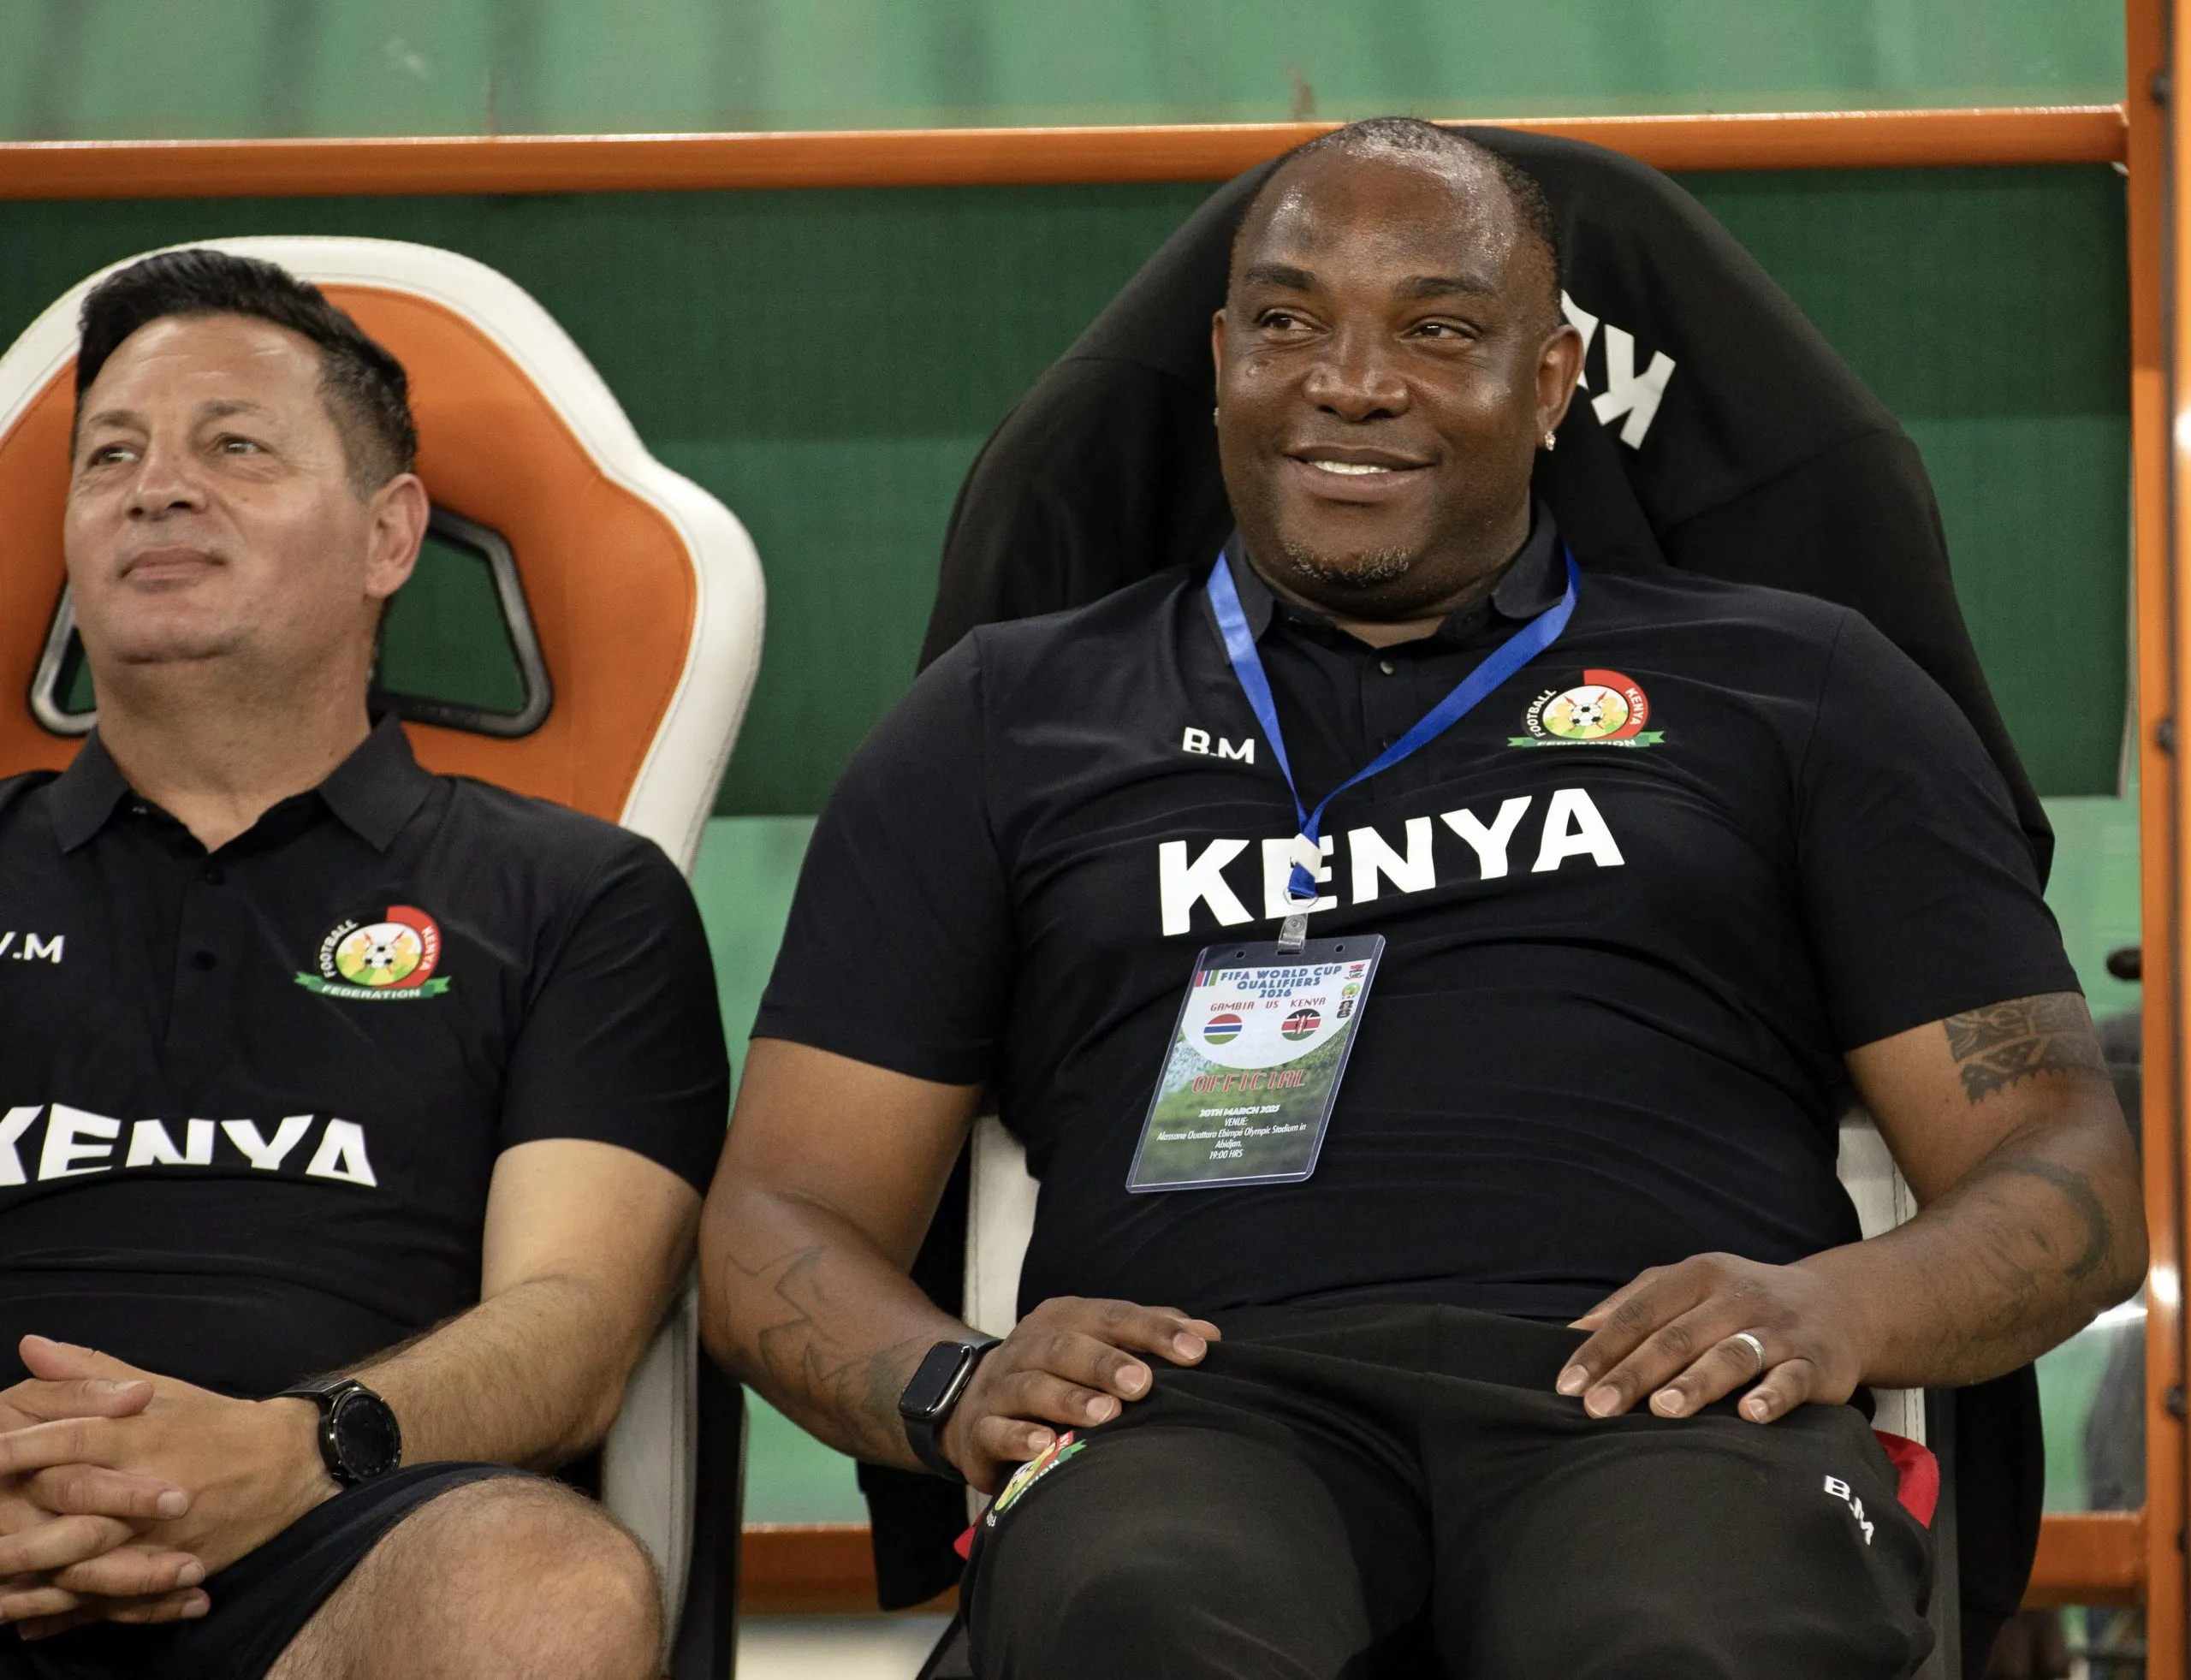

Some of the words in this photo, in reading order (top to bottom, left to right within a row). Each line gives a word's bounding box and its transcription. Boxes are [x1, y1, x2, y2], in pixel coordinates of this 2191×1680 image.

[1527, 688, 1558, 737] FOOTBALL
[1625, 687, 1644, 725] KENYA
[1183, 727, 1255, 764] B.M
[1159, 788, 1624, 936] KENYA
[319, 918, 359, 978] FOOTBALL
[419, 926, 437, 971] KENYA
[1220, 971, 1250, 982] FIFA
[1257, 968, 1308, 980] WORLD
[1314, 965, 1342, 977] CUP
[322, 984, 421, 1000] FEDERATION
[1237, 977, 1321, 990] QUALIFIERS
[1259, 988, 1292, 999] 2026
[1210, 1001, 1255, 1012] GAMBIA
[1290, 997, 1327, 1007] KENYA
[1192, 1069, 1306, 1093] OFFICIAL
[1224, 1107, 1260, 1117] MARCH
[1260, 1104, 1280, 1114] 2025
[1225, 1117, 1249, 1127] VENUE:
[1156, 1131, 1187, 1142] Alassane
[1188, 1129, 1218, 1140] Ouattara
[1244, 1125, 1270, 1137] Olympic
[1272, 1124, 1298, 1134] Stadium
[1209, 1150, 1228, 1160] 19:00
[1228, 1149, 1244, 1159] HRS
